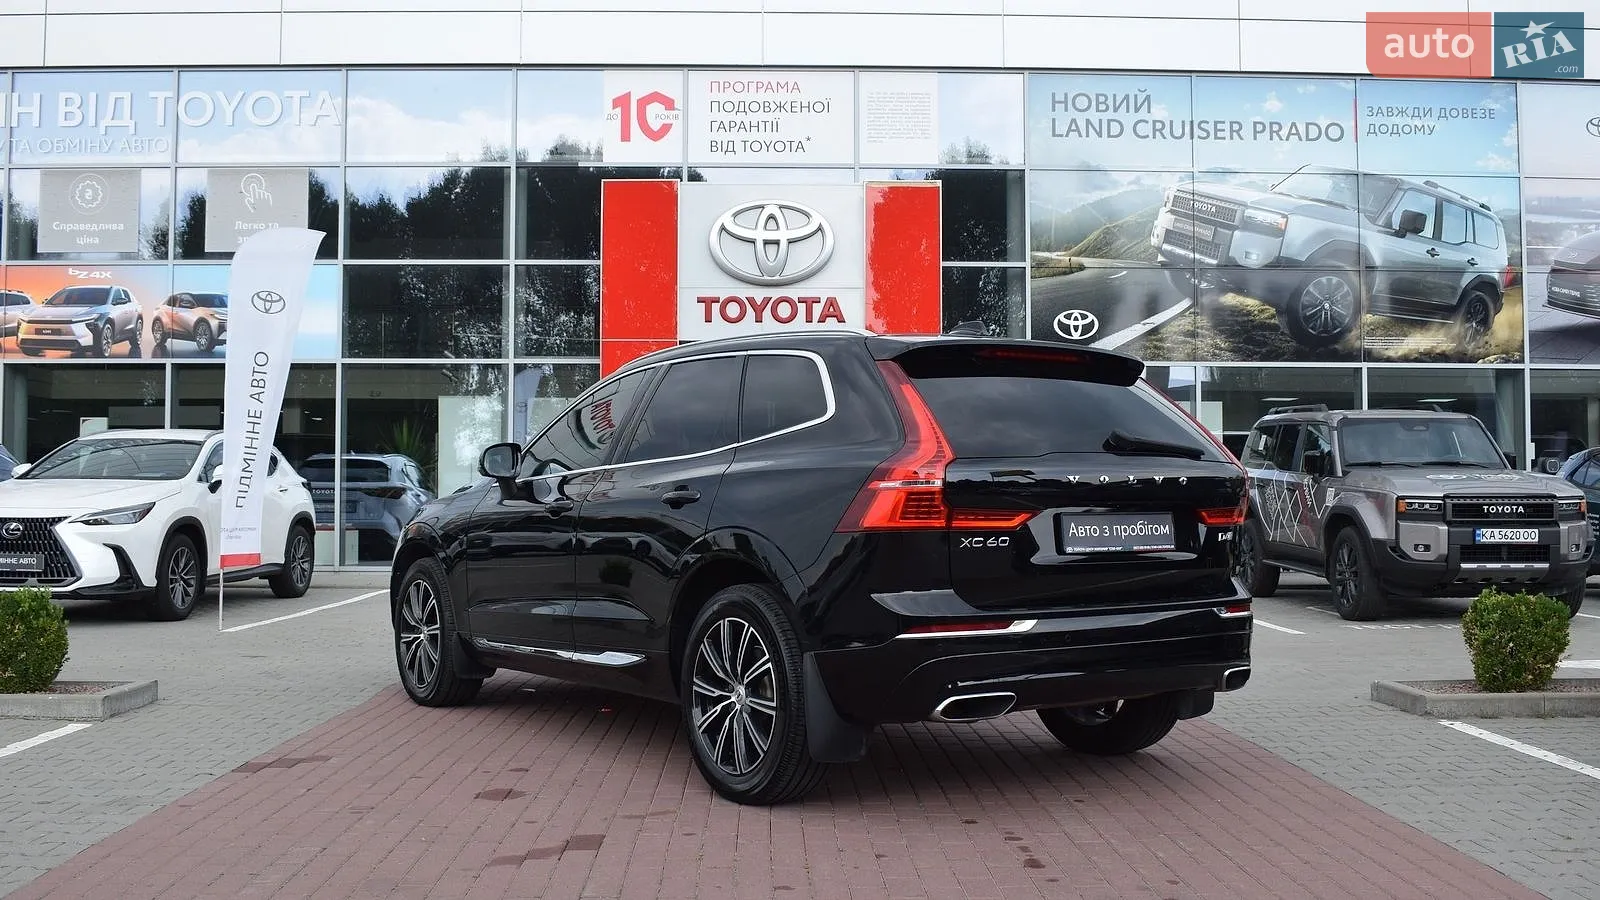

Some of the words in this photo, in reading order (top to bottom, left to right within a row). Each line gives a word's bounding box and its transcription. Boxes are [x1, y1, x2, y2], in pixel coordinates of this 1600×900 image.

[710, 80, 801, 94] ПРОГРАМА
[710, 97, 832, 116] ПОДОВЖЕНОЇ
[1051, 88, 1152, 114] НОВИЙ
[57, 91, 136, 135] ВІД
[149, 90, 342, 127] TOYOTA
[1366, 105, 1433, 121] ЗАВЖДИ
[1437, 107, 1496, 121] ДОВЕЗЕ
[710, 117, 781, 133] ГАРАНТІЇ
[1051, 118, 1125, 139] LAND
[1132, 119, 1244, 141] CRUISER
[1252, 121, 1345, 143] PRADO
[1366, 123, 1436, 137] ДОДОМУ
[37, 137, 114, 154] ОБМІНУ
[120, 138, 170, 154] АВТО
[710, 140, 736, 155] ВІД
[1190, 201, 1217, 213] TOYOTA
[52, 221, 125, 232] Справедлива
[235, 221, 266, 231] Легко
[76, 234, 100, 246] ціна
[697, 295, 846, 324] TOYOTA
[235, 409, 262, 508] ПІДМІННЕ
[250, 351, 269, 404] АВТО
[1066, 475, 1188, 486] VOLVO
[1483, 505, 1525, 513] TOYOTA
[1069, 522, 1100, 537] Авто
[1103, 525, 1110, 536] з
[1113, 520, 1170, 539] пробігом
[1481, 530, 1496, 540] KA
[1498, 530, 1520, 540] 5620
